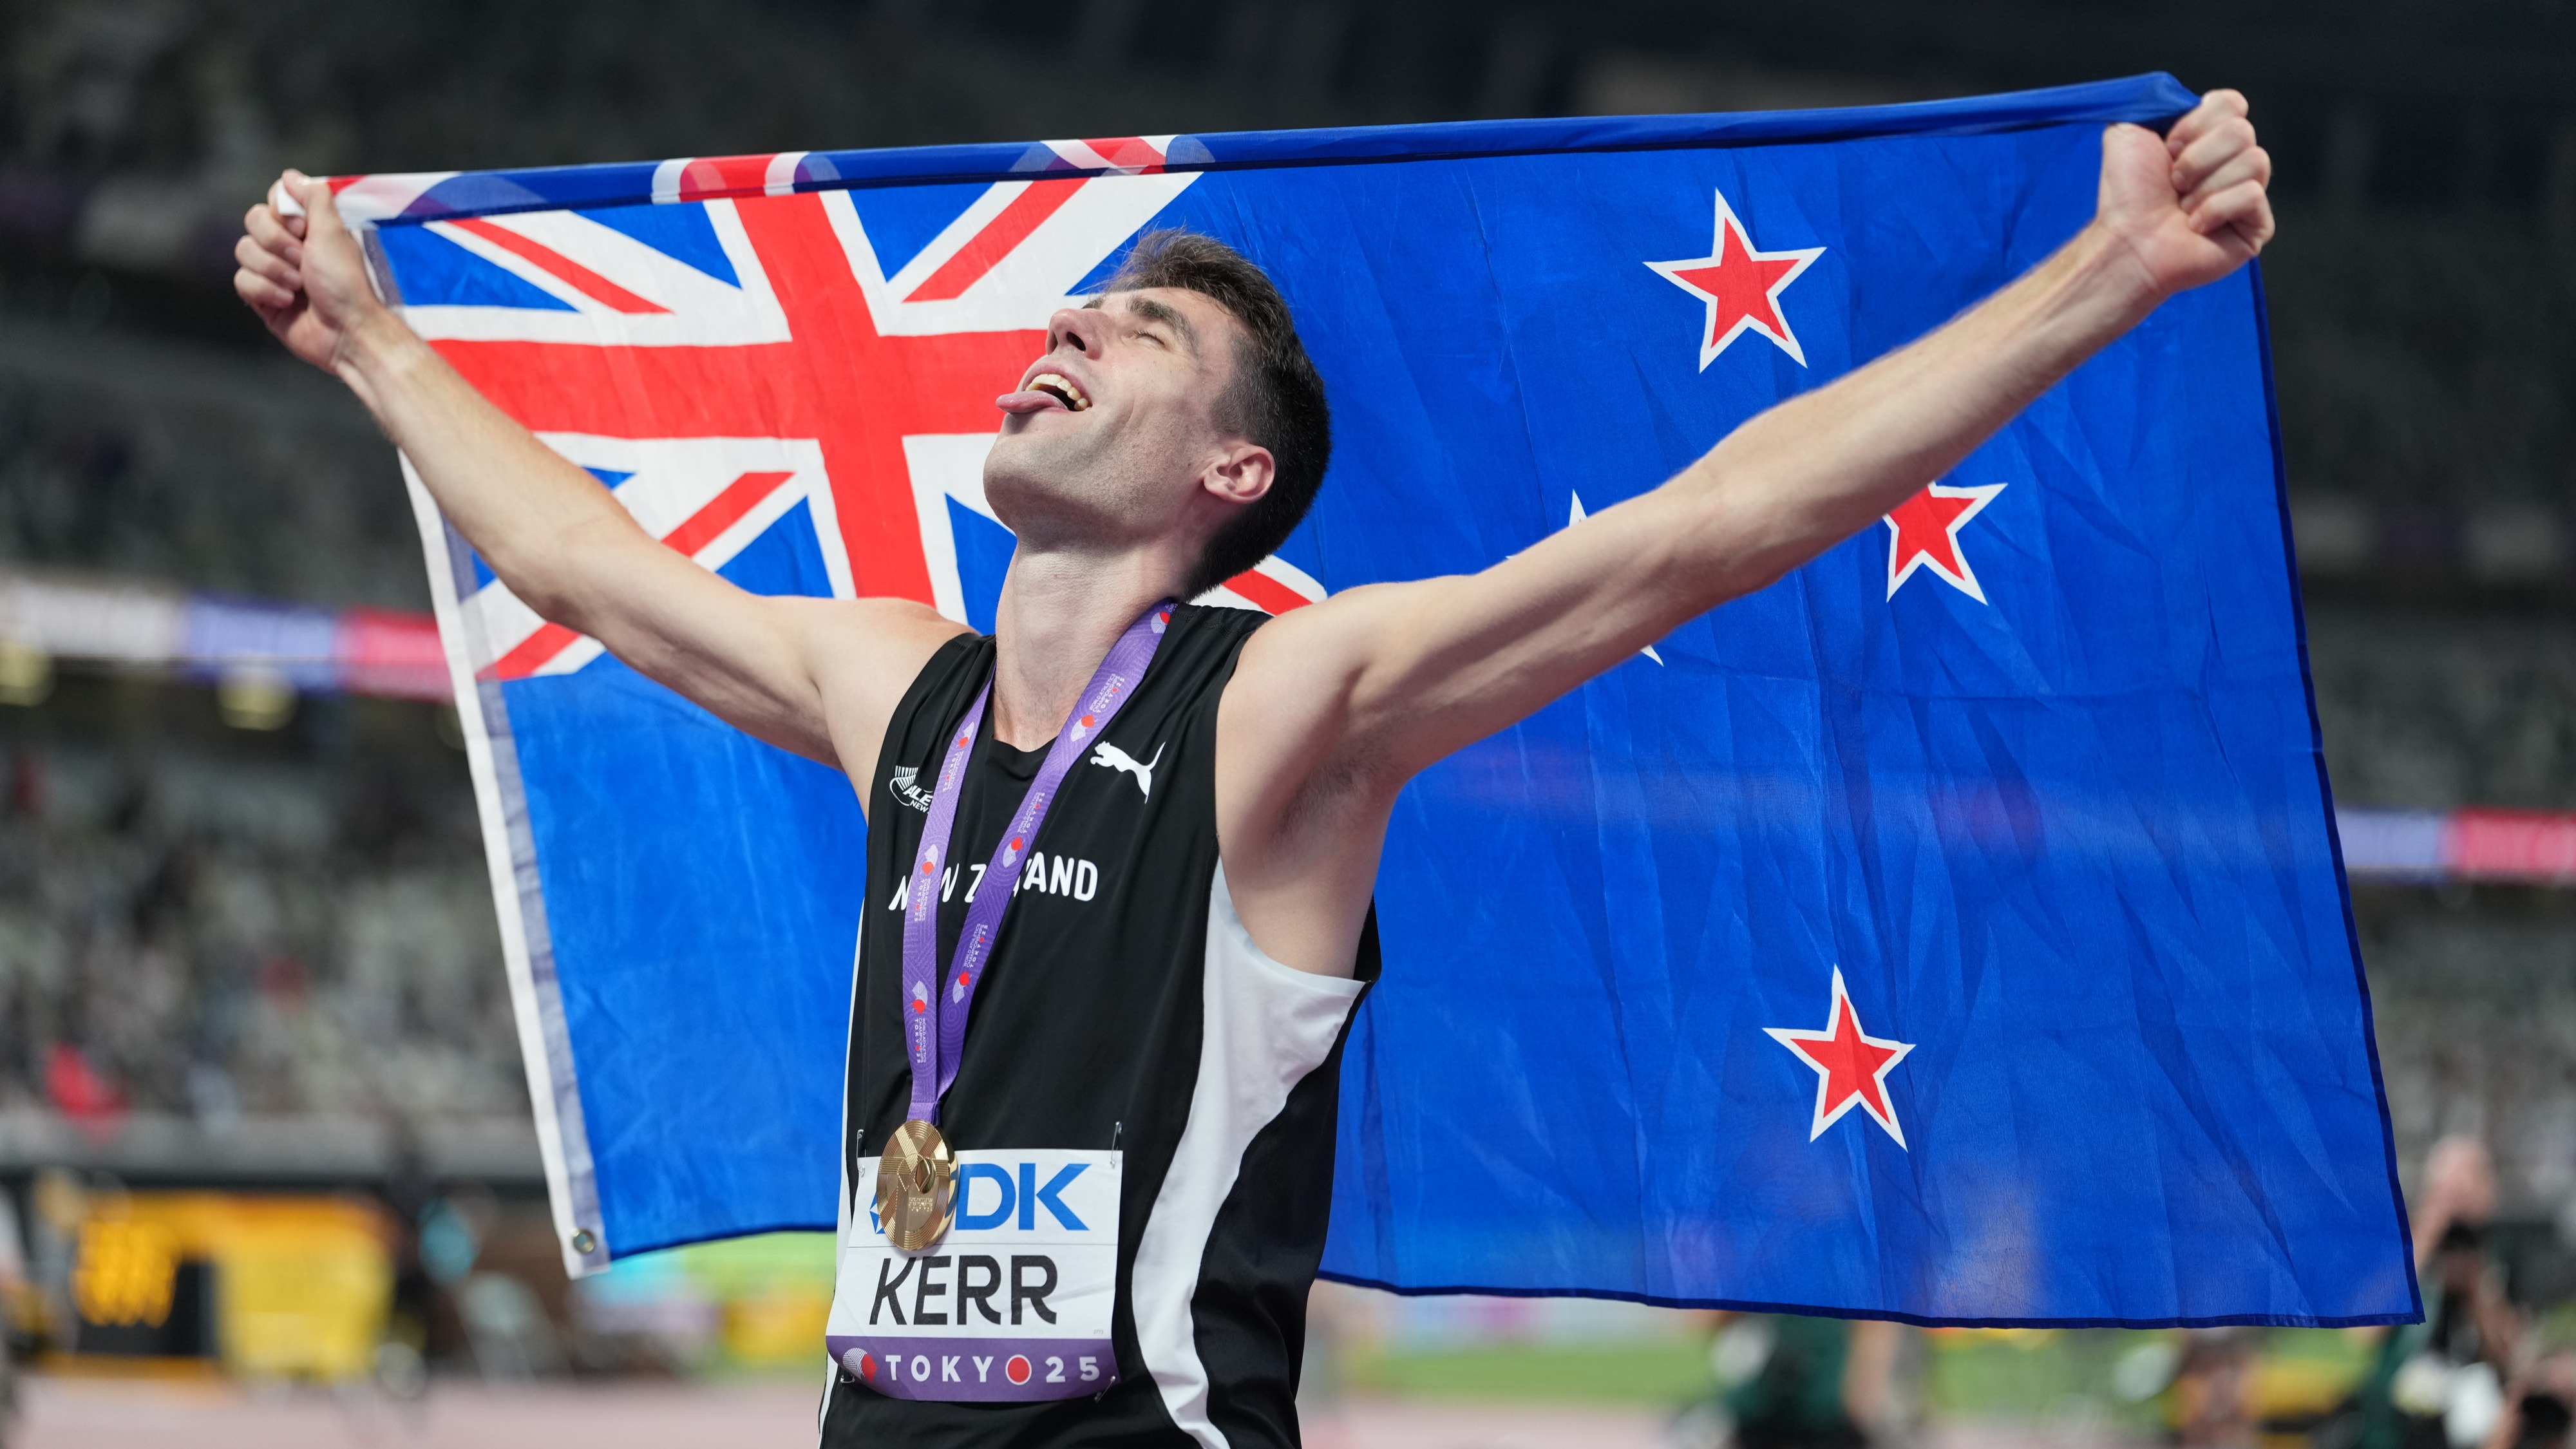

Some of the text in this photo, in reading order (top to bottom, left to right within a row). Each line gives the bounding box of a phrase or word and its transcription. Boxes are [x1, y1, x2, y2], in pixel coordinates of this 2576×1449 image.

[1090, 673, 1116, 710] WORLD ATHLETICS
[1093, 676, 1121, 712] CHAMPIONSHIPS
[909, 799, 929, 813] NEW
[888, 863, 960, 911] NW
[969, 923, 981, 949] ATHLETICS
[954, 1163, 1092, 1231] DK
[869, 1255, 1058, 1325] KERR
